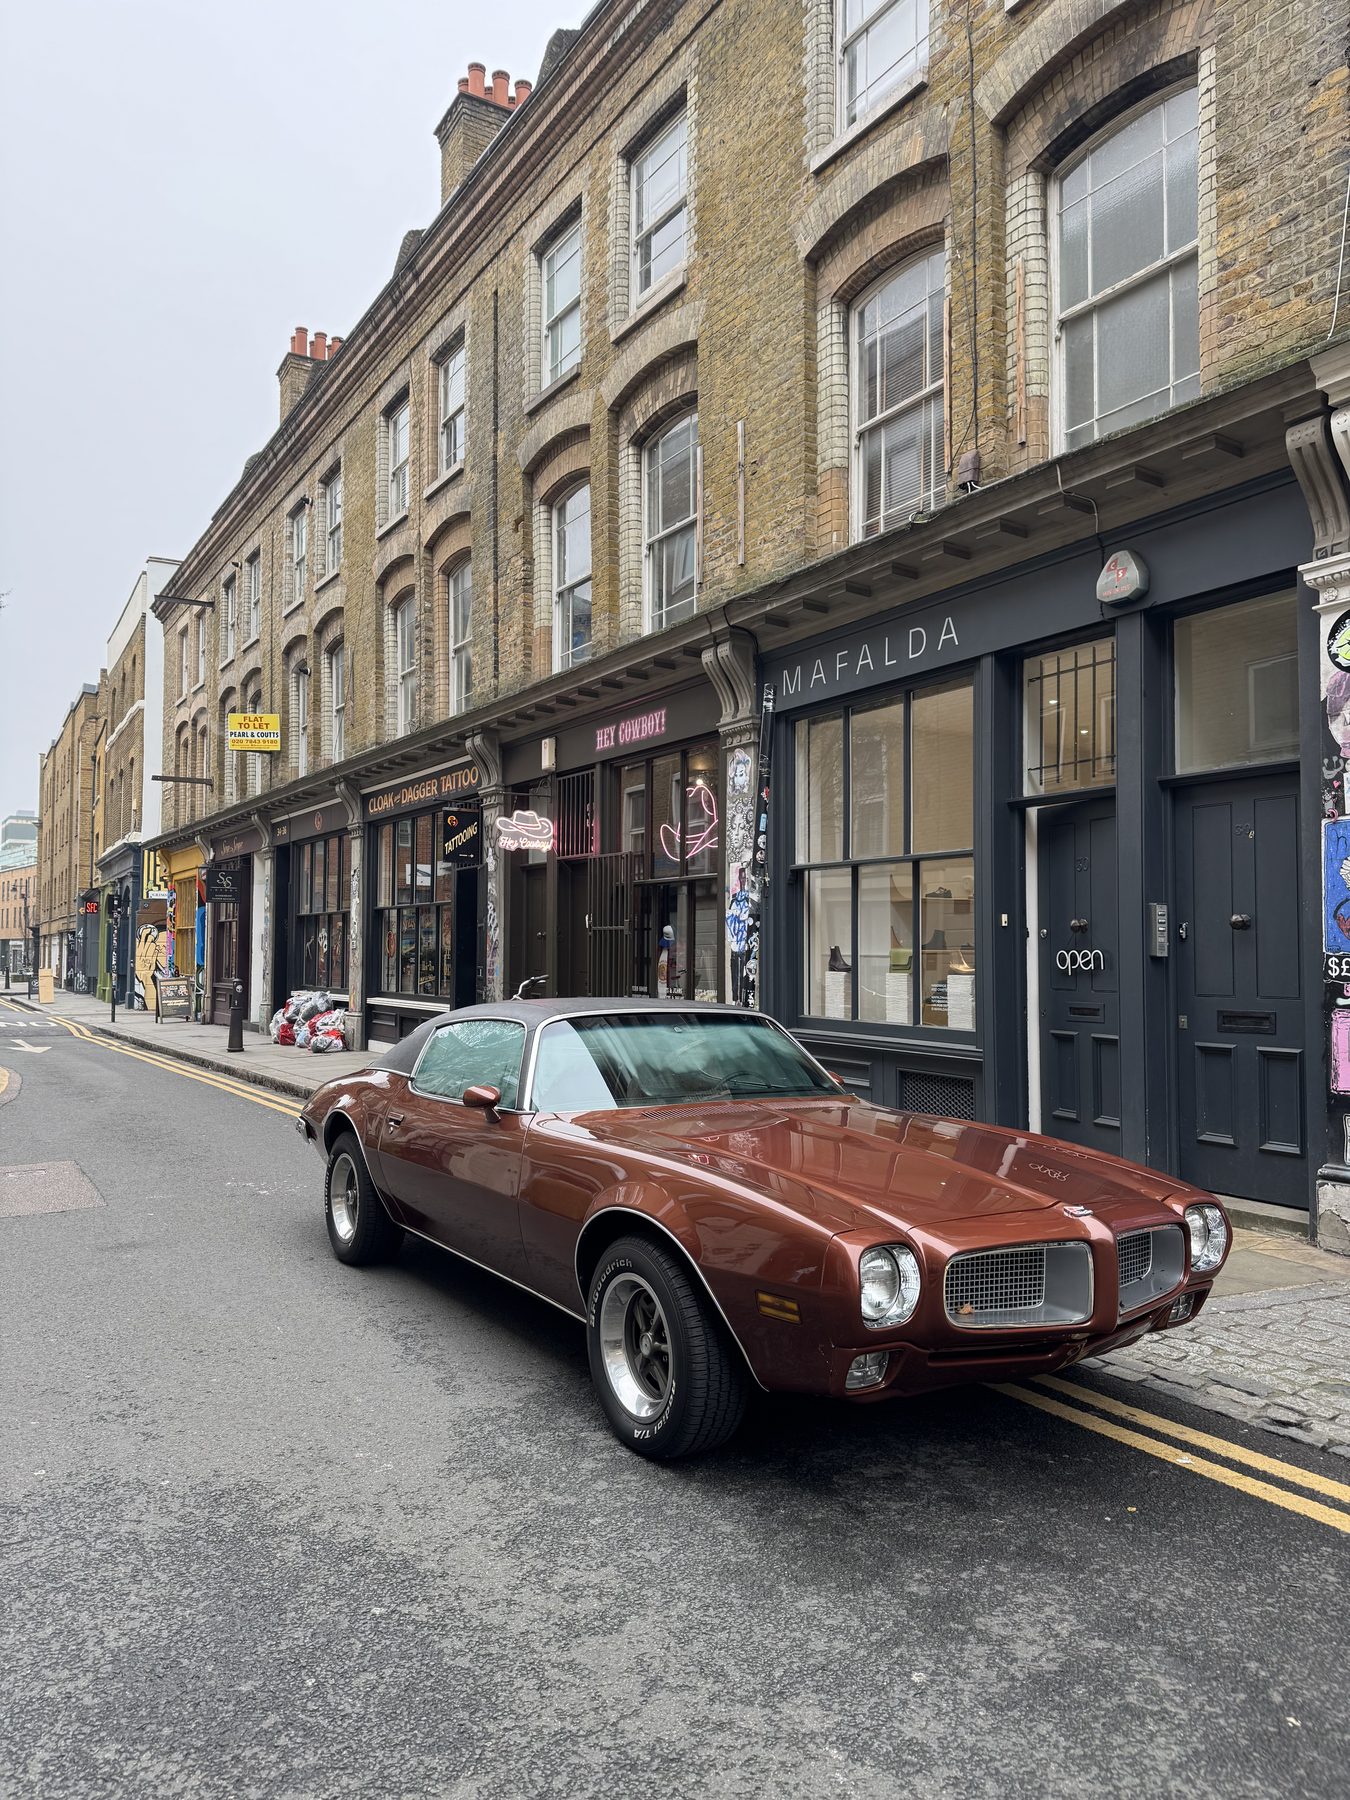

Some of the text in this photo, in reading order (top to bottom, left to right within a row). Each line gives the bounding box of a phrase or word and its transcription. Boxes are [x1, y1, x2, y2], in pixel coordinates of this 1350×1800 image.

[783, 616, 959, 697] MAFALDA
[238, 722, 270, 730] TO LET
[596, 708, 667, 751] HEY COWBOY!
[368, 791, 394, 813] CLOAK
[401, 779, 438, 805] DAGGER
[440, 766, 479, 794] TATTOO
[444, 821, 478, 855] TATTOOING
[86, 902, 98, 913] SFC
[1056, 949, 1104, 976] open
[633, 1429, 651, 1440] T/A
